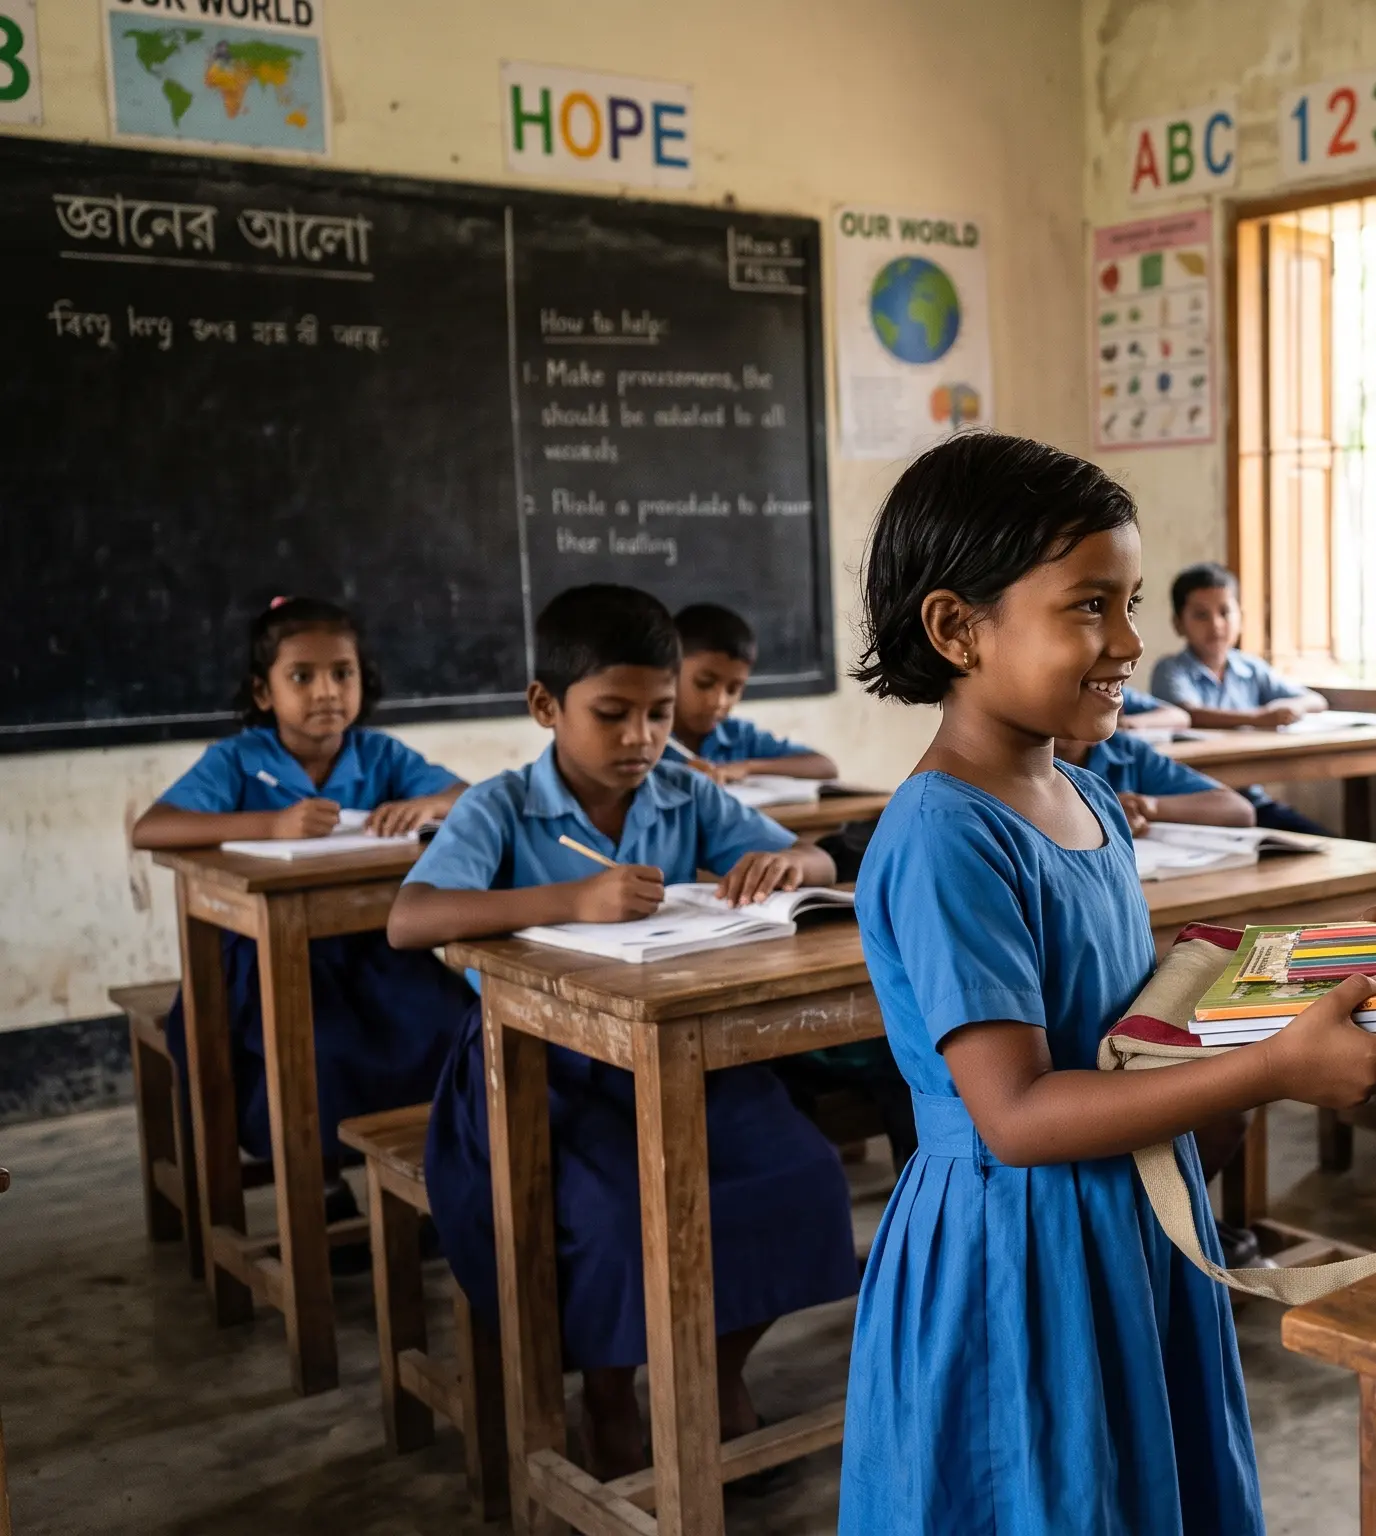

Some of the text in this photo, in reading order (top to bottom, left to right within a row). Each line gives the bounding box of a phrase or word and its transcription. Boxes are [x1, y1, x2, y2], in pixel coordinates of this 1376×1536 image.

[510, 84, 689, 169] HOPE
[1130, 110, 1234, 194] ABC
[53, 193, 373, 265] জ্ঞানের আলো
[840, 210, 980, 249] OUR WORLD
[540, 307, 584, 335] How
[592, 308, 615, 334] to
[546, 358, 606, 388] Make
[541, 401, 610, 428] should
[620, 400, 647, 428] be
[760, 404, 787, 428] all
